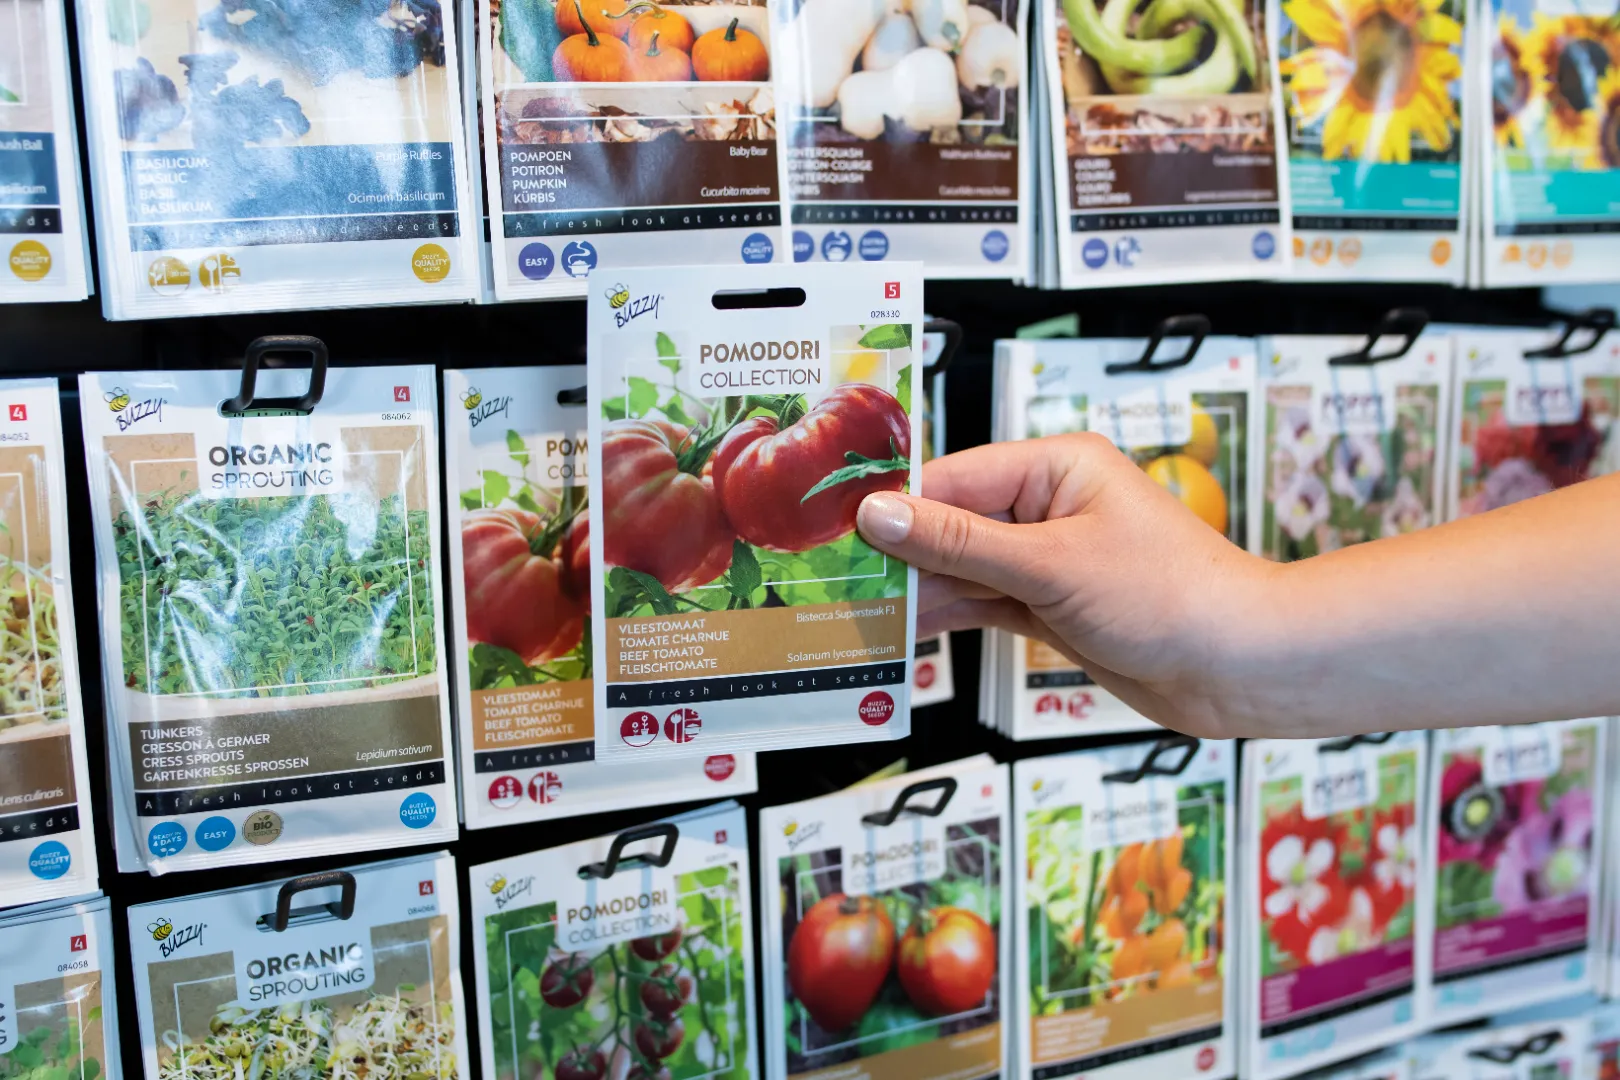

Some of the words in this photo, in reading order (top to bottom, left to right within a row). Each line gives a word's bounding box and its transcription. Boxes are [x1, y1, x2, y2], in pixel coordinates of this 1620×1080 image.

[0, 138, 21, 150] ush
[22, 138, 43, 151] Ball
[375, 150, 408, 162] Purple
[409, 149, 442, 160] Ruffles
[510, 150, 572, 163] POMPOEN
[729, 146, 750, 158] Baby
[750, 146, 768, 156] Bear
[787, 147, 864, 159] INTERSQUASH
[136, 157, 210, 170] BASILICUM
[511, 165, 564, 176] POTIRON
[137, 172, 188, 185] BASILIC
[513, 178, 567, 190] PUMPKIN
[788, 172, 864, 183] INTERSQUASH
[348, 192, 393, 204] Ocimum
[396, 190, 445, 202] basilicum
[514, 190, 556, 204] KÜRBIS
[700, 186, 740, 197] Cucurbita
[740, 185, 771, 196] maxima
[141, 201, 213, 214] BASILIKUM
[805, 209, 859, 219] fresh
[515, 221, 522, 230] A
[542, 219, 602, 229] fresh
[621, 215, 665, 226] look
[683, 214, 701, 224] at
[718, 212, 773, 223] seeds
[414, 258, 448, 268] QUALITY
[525, 257, 548, 267] EASY
[888, 283, 897, 298] 5
[614, 294, 661, 329] BUZZY
[870, 309, 901, 319] 028330
[700, 340, 820, 364] POMODORI
[700, 368, 821, 389] COLLECTION
[397, 387, 407, 401] 4
[12, 406, 24, 420] 4
[116, 398, 163, 432] BUZZY
[381, 412, 412, 421] 084062
[469, 396, 510, 428] BUZZY
[209, 443, 332, 467] ORGANIC
[211, 469, 334, 490] SPROUTING
[619, 618, 706, 635] VLEESTOMAAT
[796, 610, 834, 623] Bistecca
[835, 605, 885, 621] Supersteak
[885, 604, 896, 615] F1
[619, 635, 670, 648] TOMATE
[672, 630, 730, 644] CHARNUE
[619, 650, 650, 661] BEEF
[652, 646, 704, 659] TOMATO
[787, 651, 831, 663] Solanum
[832, 643, 896, 660] lycopersicum
[619, 658, 718, 675] FLEISCHTOMATE
[619, 692, 627, 701] A
[648, 686, 710, 699] fresh
[730, 681, 777, 693] look
[797, 677, 817, 687] at
[836, 671, 897, 684] seeds
[483, 688, 562, 705] VLEESTOMAAT
[484, 703, 529, 718] TOMATE
[531, 698, 585, 712] CHARNUE
[860, 703, 893, 714] QUALITY
[484, 718, 512, 731] BEEF
[515, 712, 562, 727] TOMATO
[140, 725, 204, 740] TUINKERS
[485, 723, 575, 742] FLEISCHTOMATE
[141, 740, 202, 755] CRESSON
[205, 735, 215, 749] À
[217, 733, 271, 748] GERMER
[142, 756, 183, 769] CRESS
[186, 750, 245, 765] SPROUTS
[143, 764, 243, 783] GARTENKRESSE
[245, 757, 310, 774] SPROSSEN
[356, 748, 398, 762] Lepidium
[398, 744, 433, 757] sativum
[486, 757, 493, 767] A
[512, 750, 569, 764] fresh
[23, 787, 64, 802] culinaris
[145, 800, 153, 810] A
[174, 791, 241, 807] fresh
[262, 783, 313, 799] look
[333, 779, 354, 791] at
[373, 770, 436, 786] seeds
[401, 806, 436, 816] QUALITY
[253, 820, 273, 831] BIO
[153, 833, 173, 841] READY
[160, 835, 182, 846] DAYS
[203, 830, 228, 840] EASY
[30, 854, 70, 867] QUALITY
[566, 889, 668, 924] POMODORI
[568, 911, 671, 945] COLLECTION
[74, 937, 83, 950] 4
[159, 922, 204, 958] BUZZY
[57, 959, 89, 973] 084058
[246, 942, 364, 980] ORGANIC
[249, 966, 365, 1002] SPROUTING
